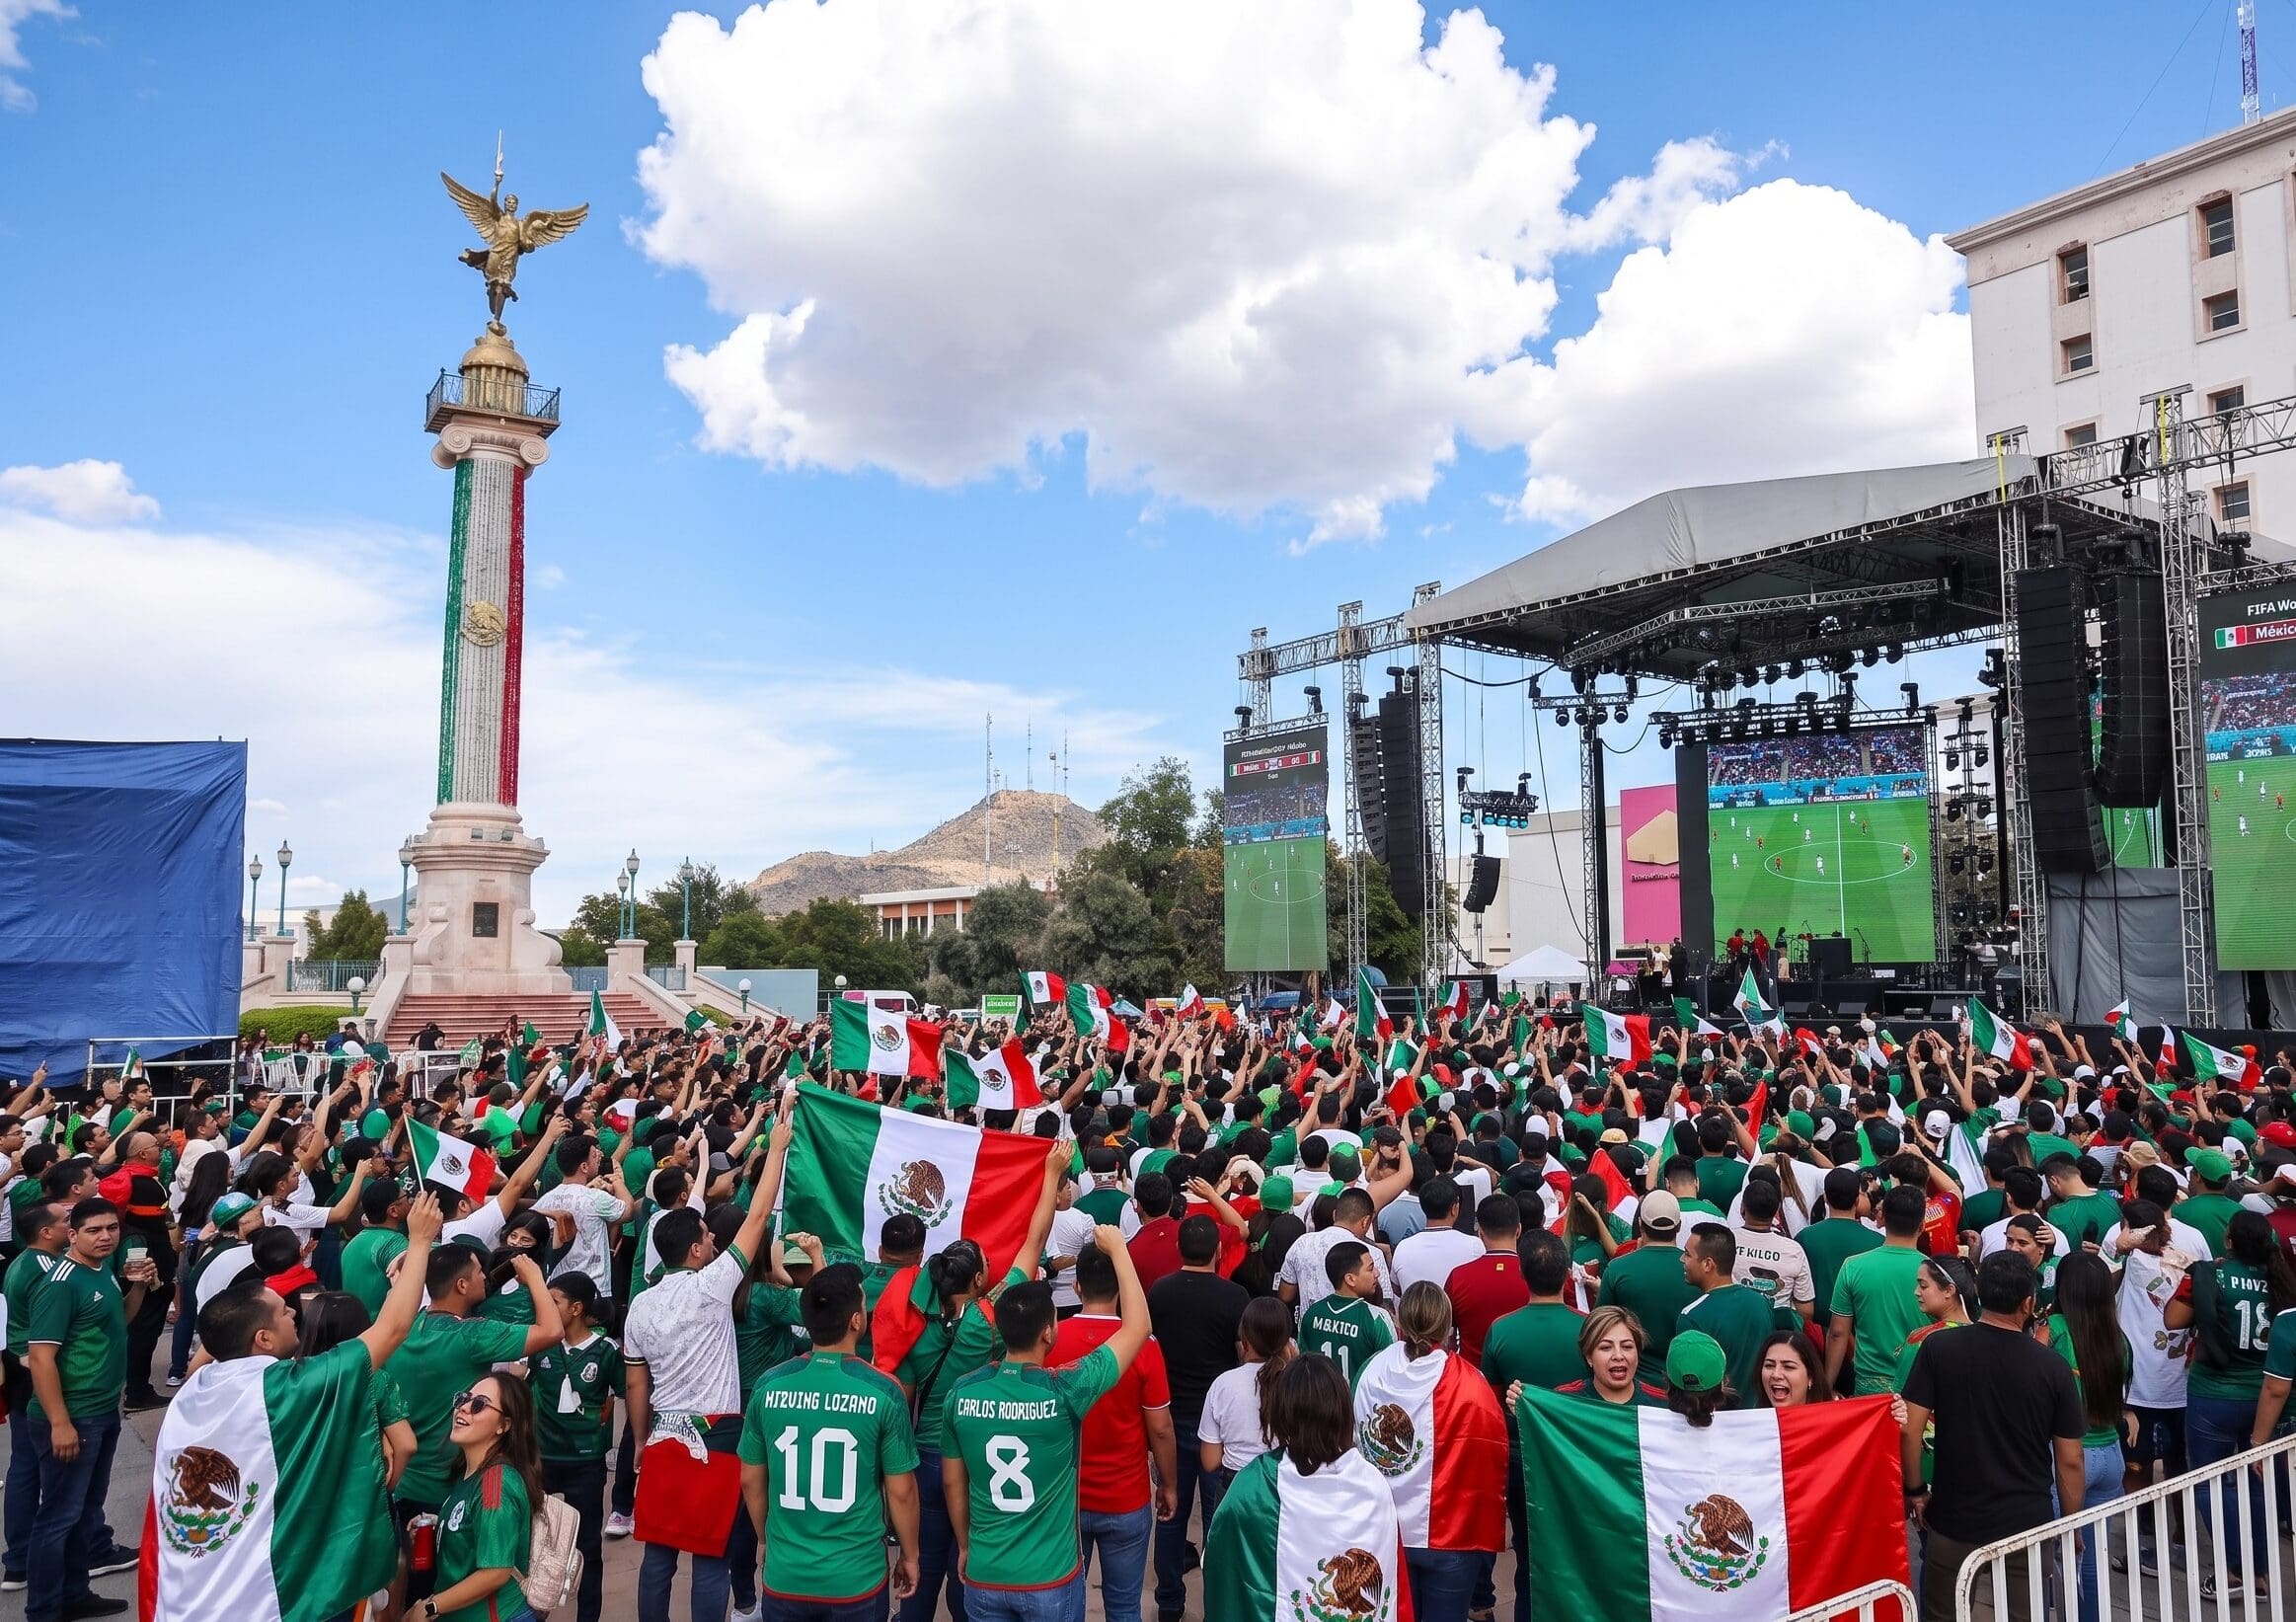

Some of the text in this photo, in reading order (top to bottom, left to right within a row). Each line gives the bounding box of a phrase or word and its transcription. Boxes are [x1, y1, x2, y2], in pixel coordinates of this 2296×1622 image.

[2248, 601, 2276, 617] FIFA
[824, 1392, 878, 1416] LOZANO
[957, 1398, 1058, 1422] CARLOS RODRIGUEZ
[774, 1425, 859, 1514] 10
[985, 1434, 1035, 1513] 8
